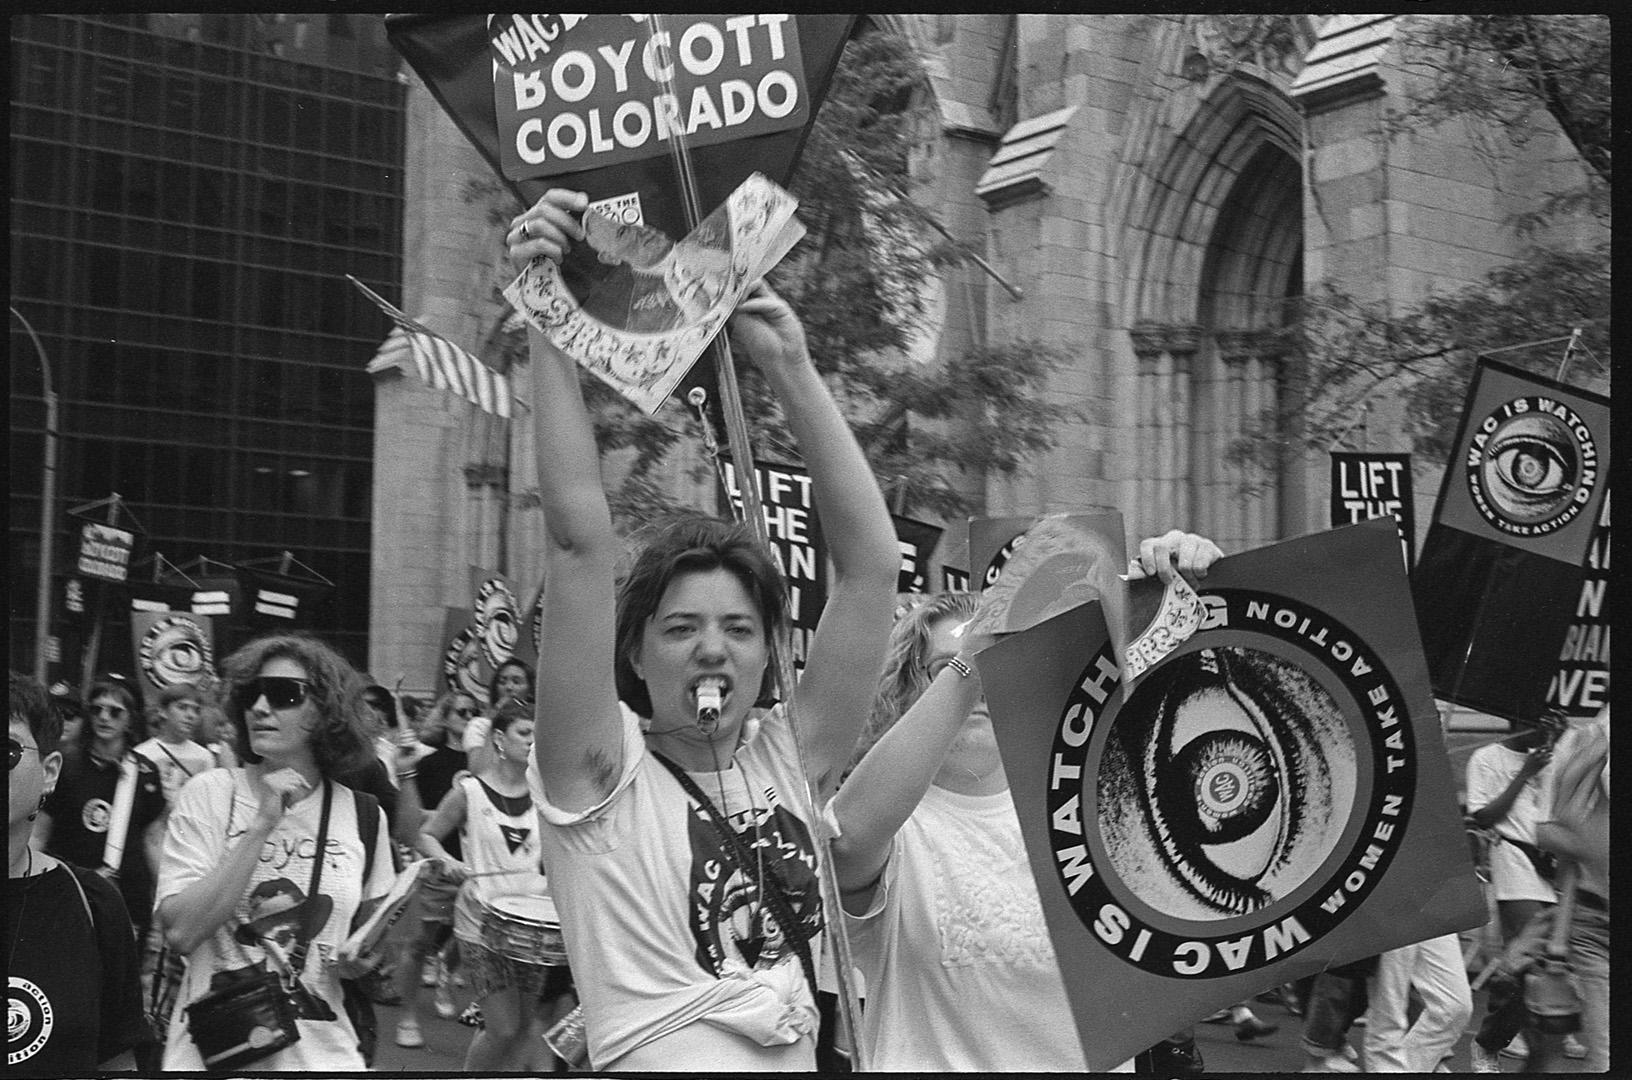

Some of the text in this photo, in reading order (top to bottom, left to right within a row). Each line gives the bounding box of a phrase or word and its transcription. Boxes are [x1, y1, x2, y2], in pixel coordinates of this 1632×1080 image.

[513, 15, 789, 111] BOYCOTT
[516, 70, 799, 165] COLORADO
[1340, 461, 1404, 498] LIFT
[1467, 397, 1597, 504] WAC IS WATCHING
[1532, 505, 1579, 534] ACTION
[1051, 594, 1312, 976] WAC IS WATCHG
[1213, 773, 1236, 802] WAC
[1246, 600, 1405, 914] WOMEN TAKE ACTION
[22, 982, 52, 1026] action
